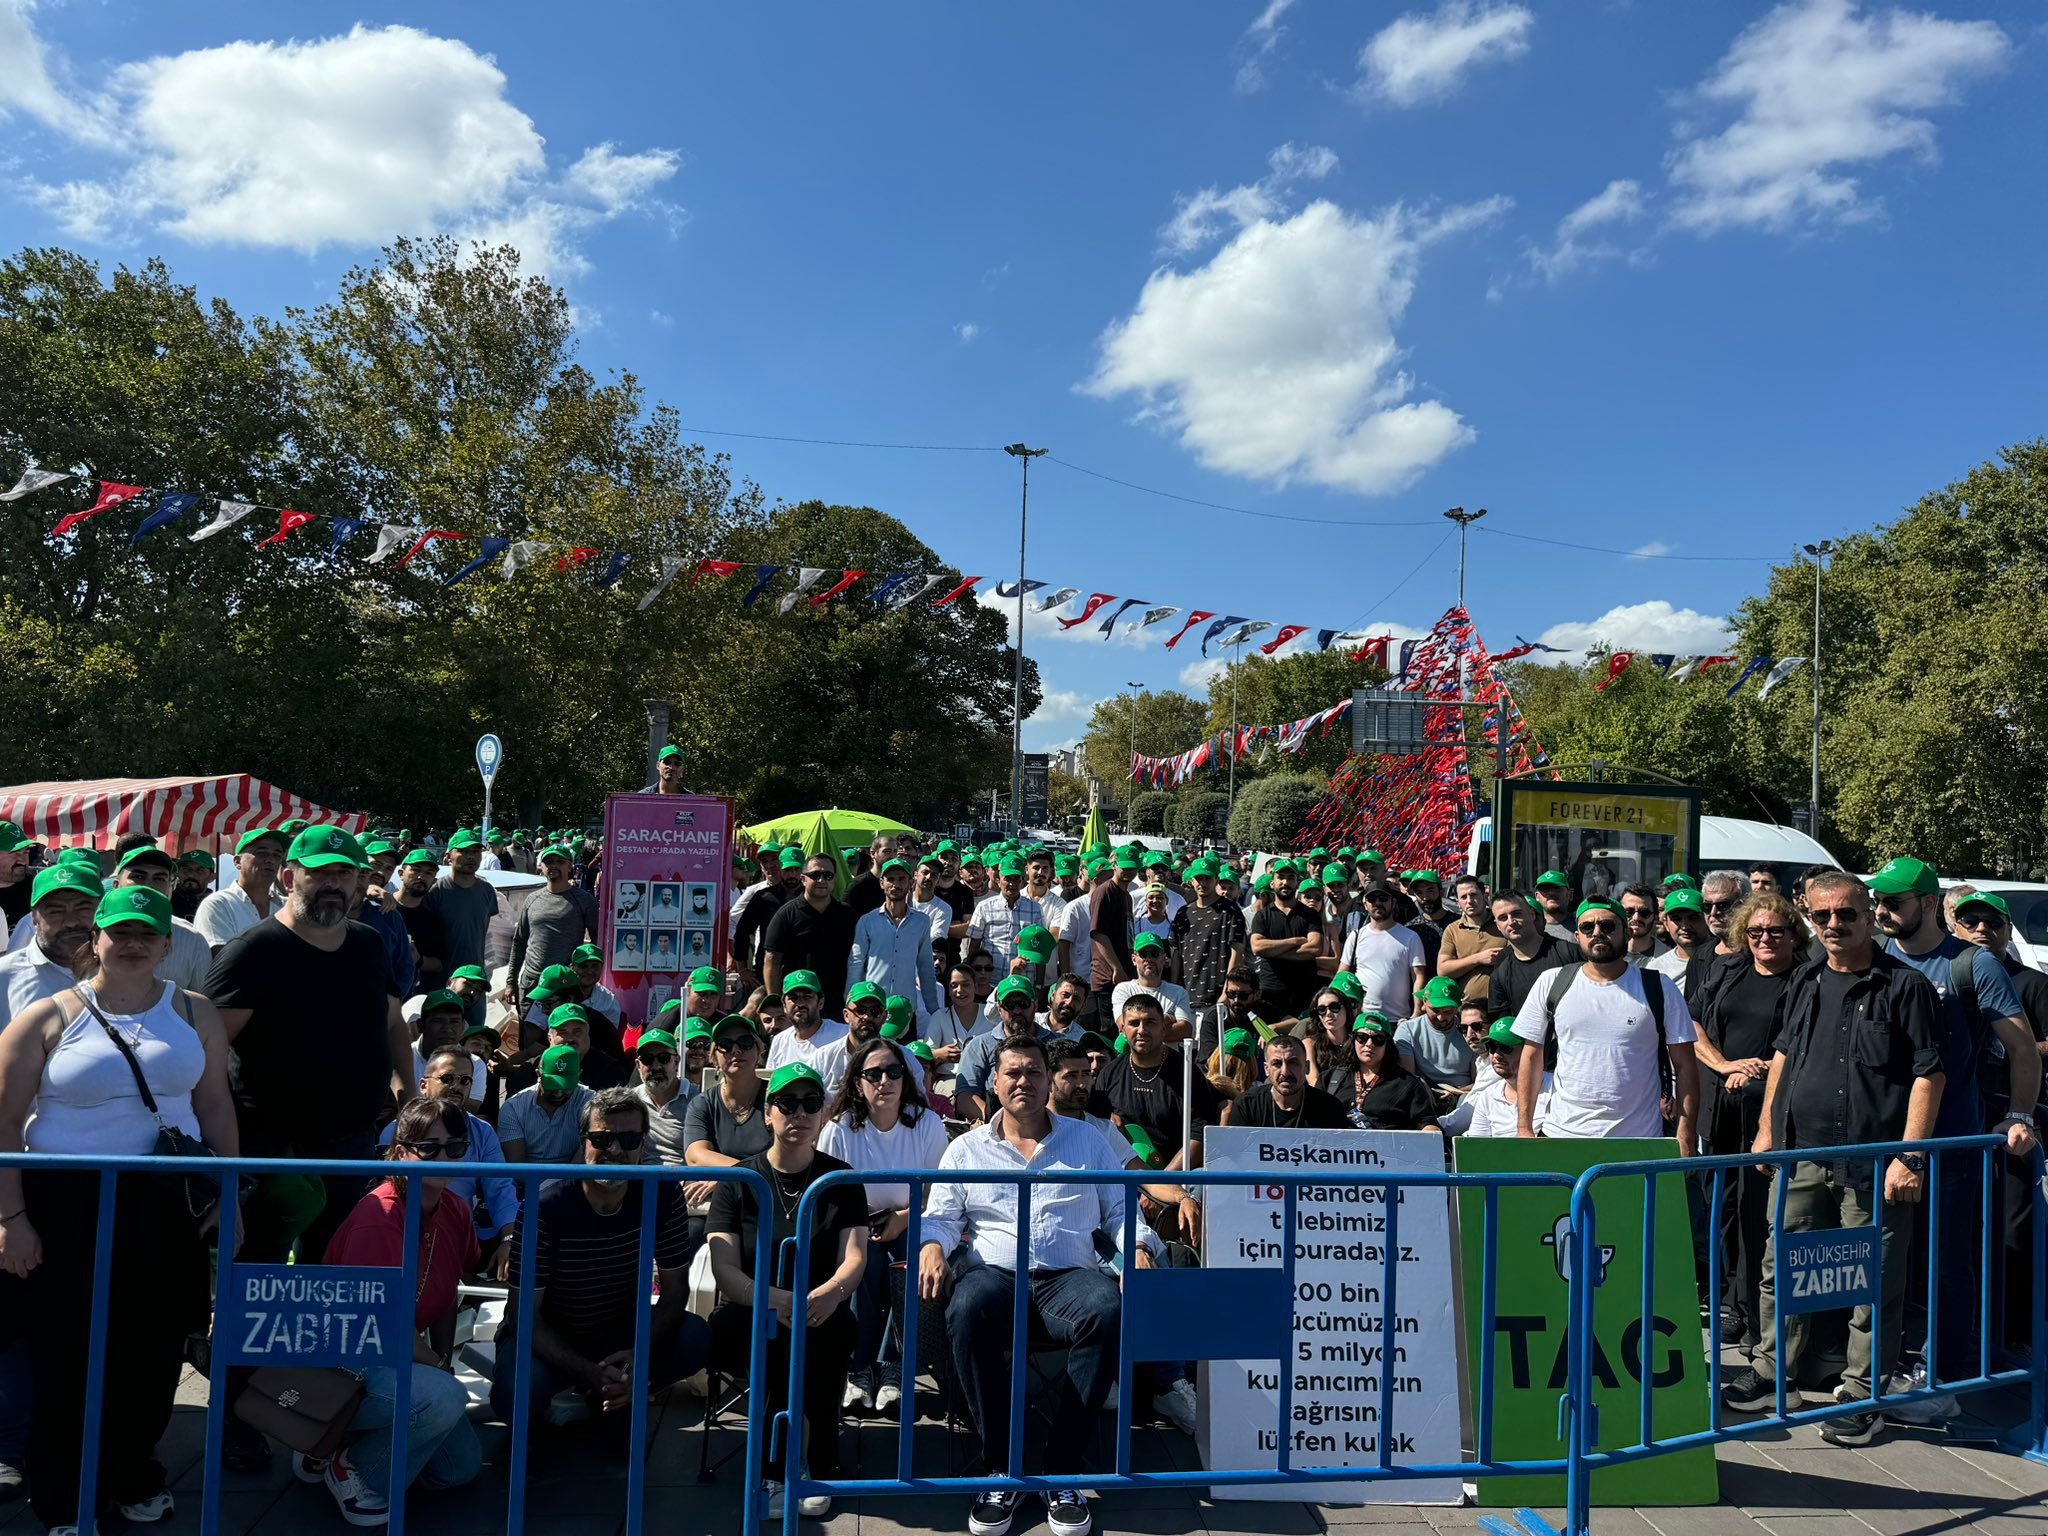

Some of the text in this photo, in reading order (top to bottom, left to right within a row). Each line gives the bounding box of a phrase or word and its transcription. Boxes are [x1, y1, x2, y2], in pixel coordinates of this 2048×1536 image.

[1550, 802, 1643, 824] FOREVER 21
[618, 828, 720, 845] SARAÇHANE
[616, 845, 649, 854] DESTAN
[1259, 1143, 1385, 1168] Başkanım,
[1298, 1185, 1404, 1204] Randevu
[1270, 1210, 1386, 1232] tlebimiz
[1239, 1238, 1281, 1261] için
[1789, 1240, 1871, 1267] BÜYÜKŞEHİR
[1792, 1264, 1868, 1298] ZABITA
[1341, 1283, 1379, 1303] bin
[242, 1312, 383, 1355] ZABITA
[1495, 1315, 1685, 1389] TAG
[1247, 1369, 1421, 1392] kuanıcımzın
[1290, 1400, 1381, 1425] ağrısın
[1345, 1431, 1416, 1453] kuak
